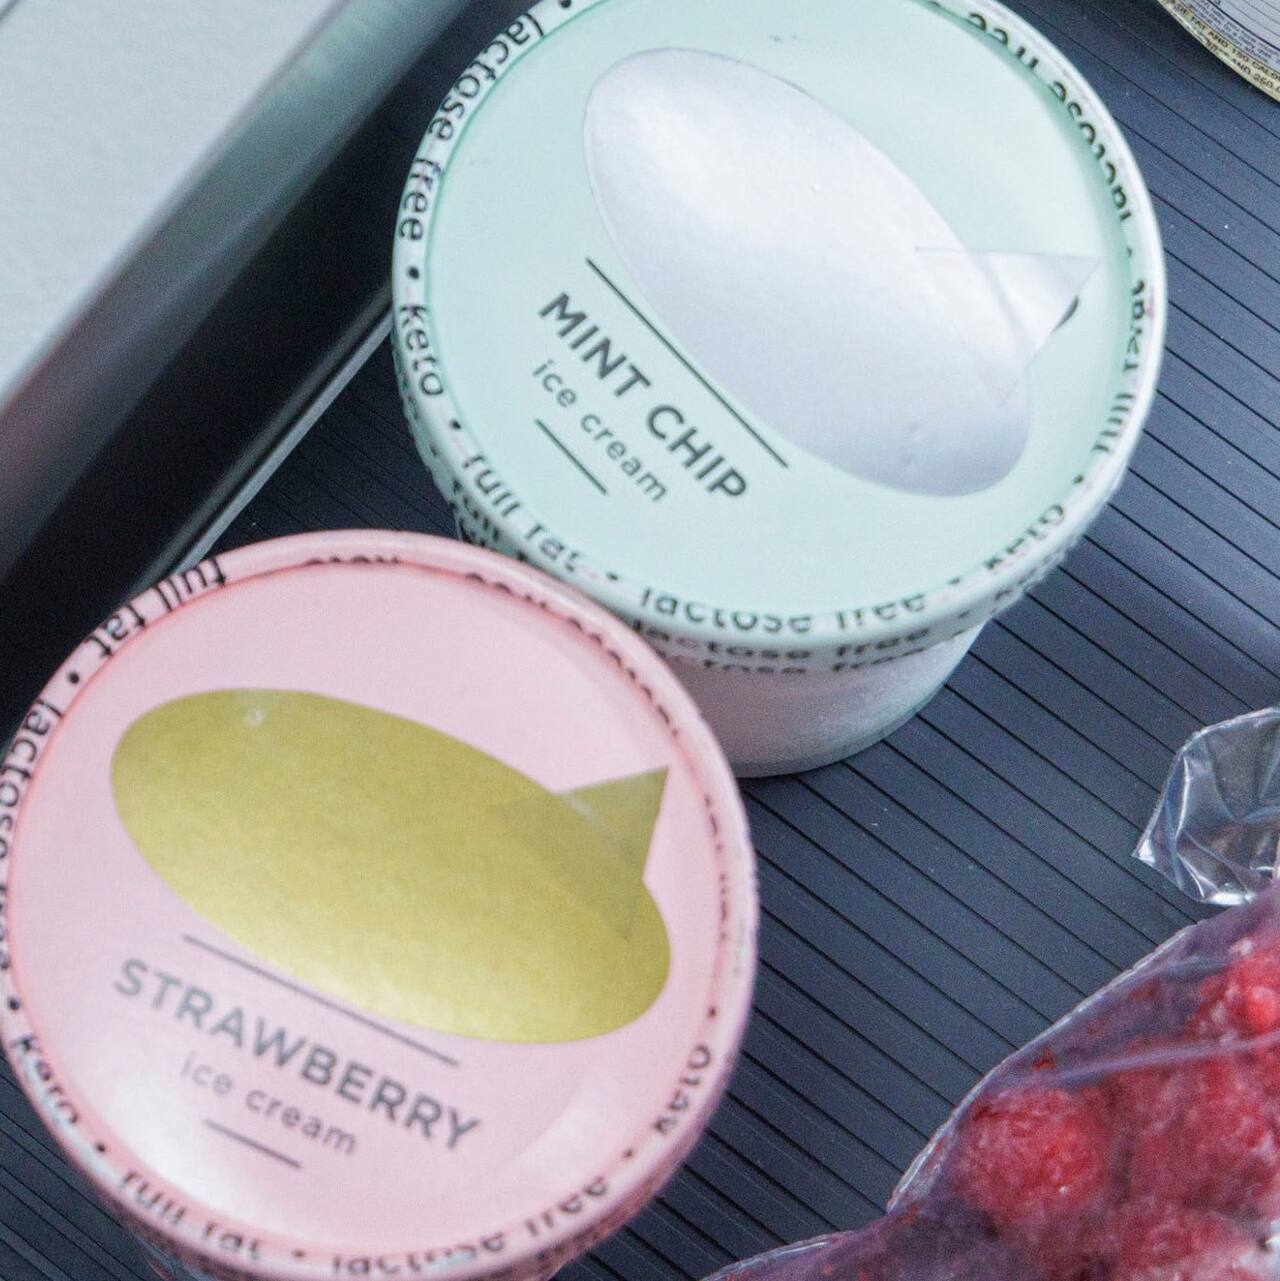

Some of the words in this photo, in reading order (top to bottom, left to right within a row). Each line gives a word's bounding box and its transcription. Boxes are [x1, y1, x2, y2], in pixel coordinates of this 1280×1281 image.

[427, 12, 545, 142] lactose
[398, 157, 442, 242] free
[532, 359, 579, 408] ice
[579, 413, 668, 503] cream
[538, 291, 652, 397] MINT
[645, 404, 748, 498] CHIP
[85, 604, 147, 658] fat
[113, 958, 481, 1150] STRAWBERRY
[179, 1051, 234, 1096] ice
[244, 1088, 357, 1157] cream
